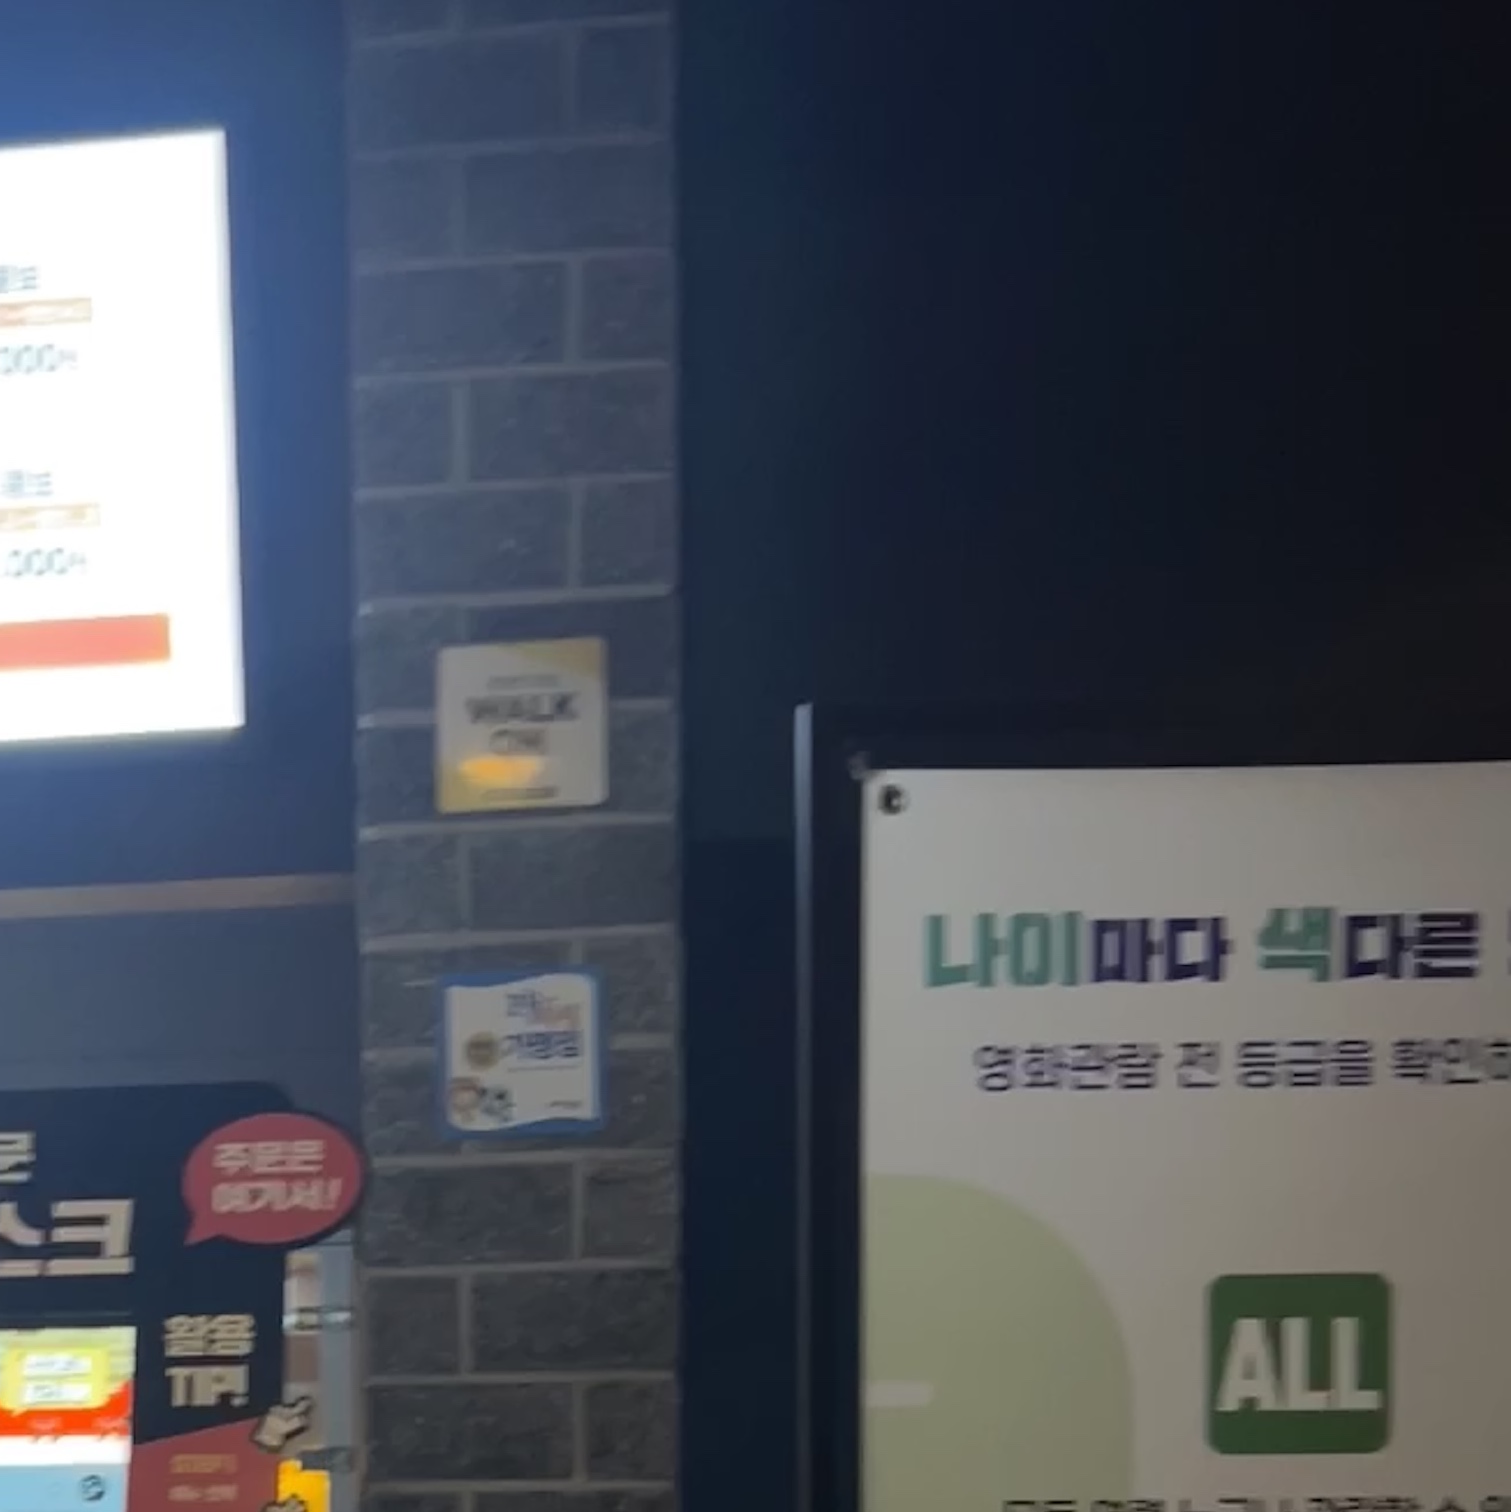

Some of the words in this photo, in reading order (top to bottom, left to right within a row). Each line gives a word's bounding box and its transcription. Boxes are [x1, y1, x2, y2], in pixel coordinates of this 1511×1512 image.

[922, 910, 1234, 988] 나이마다
[1257, 907, 1482, 982] 색다른
[973, 1042, 1162, 1091] 영화관람
[1175, 1041, 1220, 1089] 전
[1237, 1039, 1372, 1087] 등급을
[213, 1140, 325, 1174] 주문은
[211, 1179, 341, 1212] 여기서!
[162, 1314, 254, 1356] 활용
[1215, 1315, 1383, 1412] ALL
